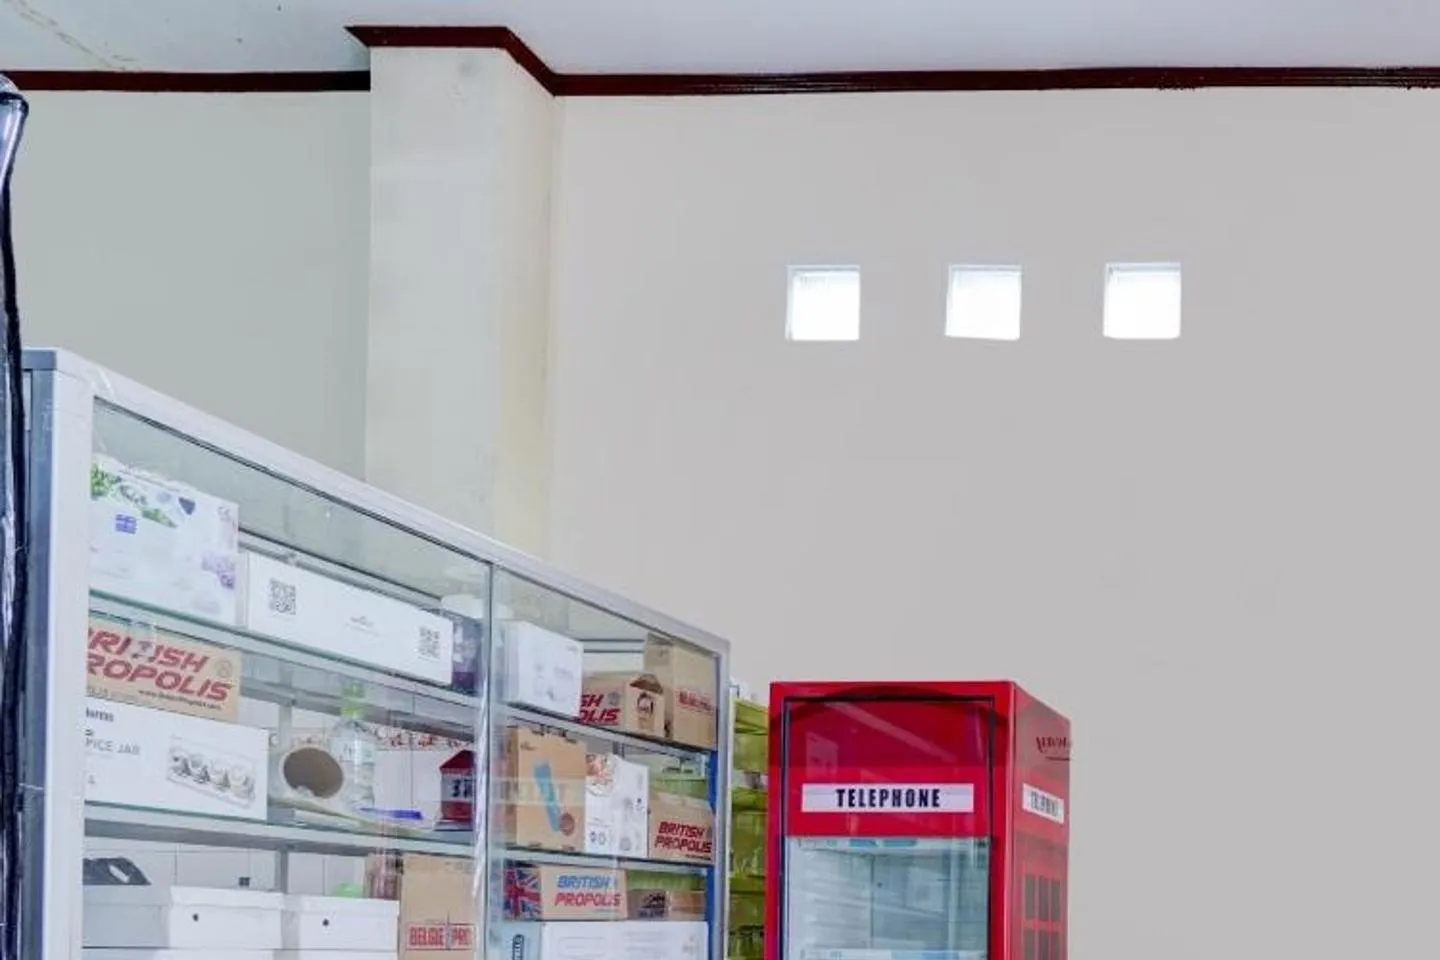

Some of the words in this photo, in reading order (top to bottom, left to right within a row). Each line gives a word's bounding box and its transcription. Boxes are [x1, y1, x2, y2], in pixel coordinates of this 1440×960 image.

[836, 788, 940, 808] TELEPHONE
[658, 821, 704, 838] BRITISH
[654, 836, 713, 853] PROPOLIS
[554, 892, 622, 907] PROPOLIS
